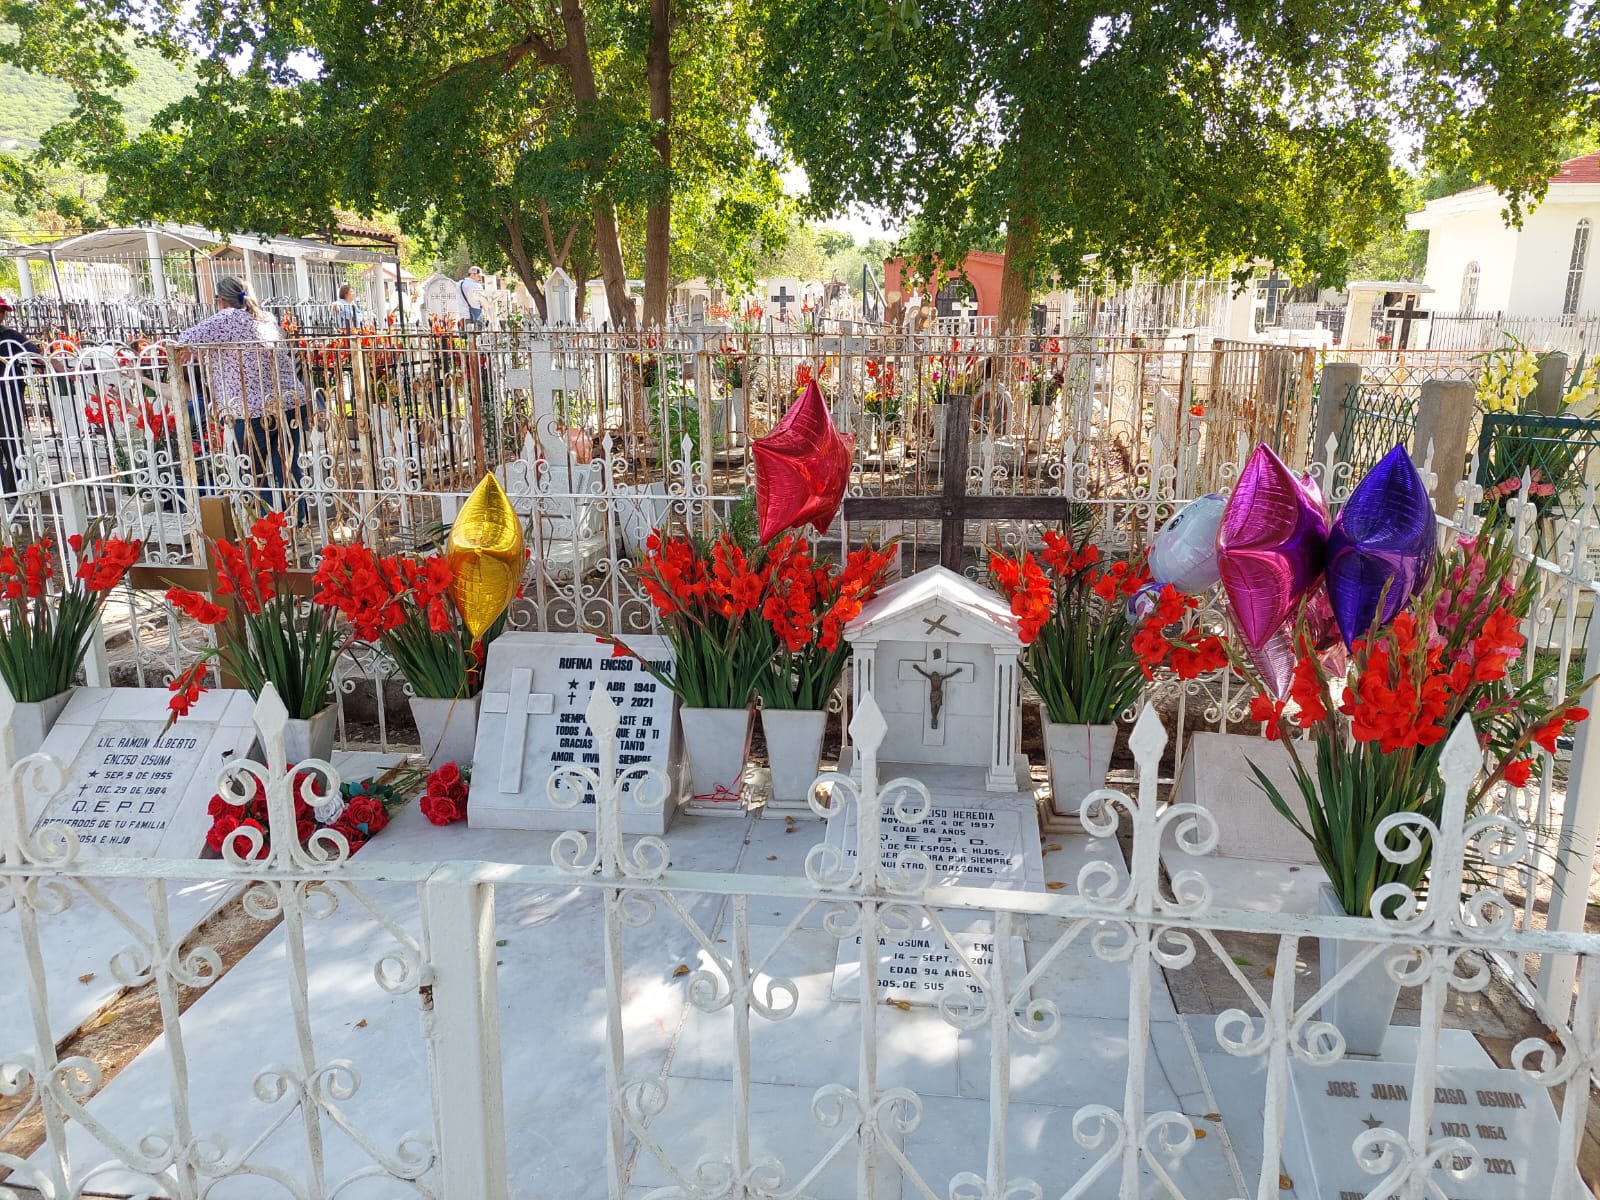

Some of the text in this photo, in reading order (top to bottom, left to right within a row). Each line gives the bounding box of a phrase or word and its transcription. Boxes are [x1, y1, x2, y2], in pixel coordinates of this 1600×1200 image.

[559, 657, 592, 670] RUFINA
[600, 659, 633, 671] ENCISO
[606, 681, 626, 691] ABR
[633, 682, 657, 693] 1940
[630, 697, 654, 708] 2021
[560, 713, 586, 723] SIEMP
[642, 716, 653, 726] EN
[556, 725, 579, 736] TODOS
[615, 728, 631, 738] QUE
[636, 729, 646, 739] EN
[652, 729, 660, 739] TI
[97, 737, 197, 749] LIC. RAMON ALBERTO
[560, 738, 645, 751] GRACIAS TANTO
[103, 754, 172, 766] ENCISO OSUNA
[135, 772, 149, 780] DE
[151, 772, 174, 780] 1955
[95, 785, 167, 795] DIC. 29 DE 1984
[953, 810, 995, 821] HEREDIA
[98, 819, 111, 828] DE
[114, 820, 127, 828] TU
[128, 820, 166, 830] FAMILIA
[970, 821, 995, 829] 1997
[893, 825, 917, 833] EDAD
[942, 827, 967, 836] AÑOS
[100, 836, 107, 844] E
[920, 845, 957, 853] ESPOSA
[948, 855, 966, 863] POR
[970, 857, 1013, 866] SIEMPRE
[894, 952, 905, 960] 14
[889, 966, 972, 978] EDAD 94 AÑOS
[923, 982, 945, 990] SUS
[1325, 1080, 1527, 1109] JOSE JUAN CISO OSUNA
[1441, 1122, 1471, 1138] MZO
[1483, 1157, 1516, 1175] 2021
